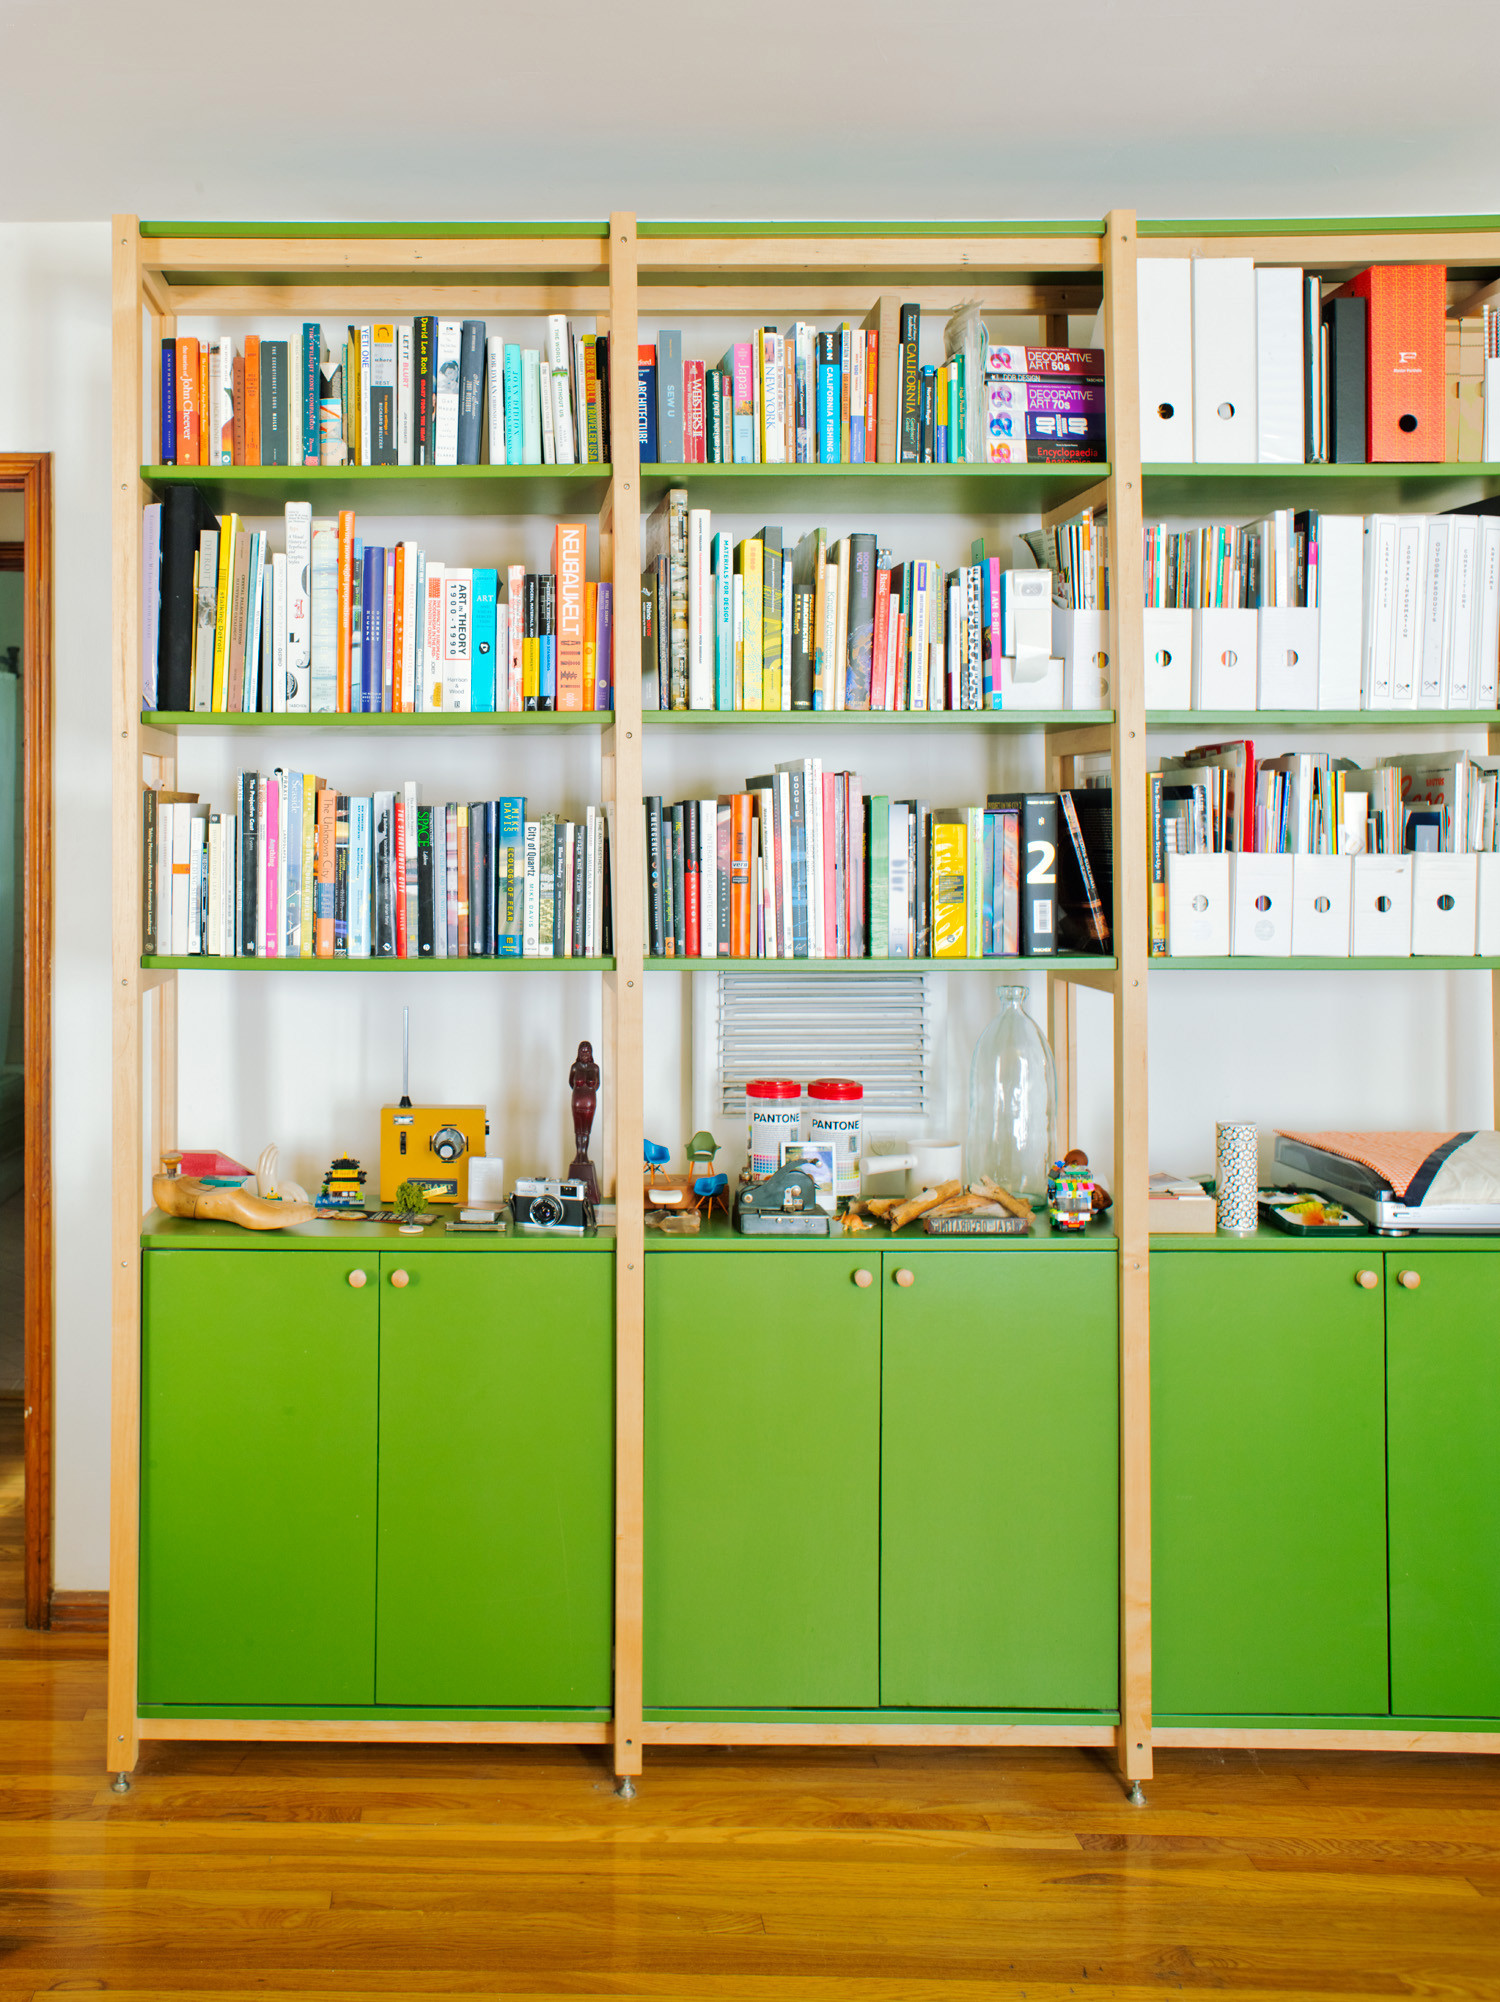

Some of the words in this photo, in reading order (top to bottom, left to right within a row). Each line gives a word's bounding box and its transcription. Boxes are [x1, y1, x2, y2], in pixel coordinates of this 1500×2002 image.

[361, 329, 369, 347] YETI
[420, 317, 428, 339] David
[361, 350, 369, 368] ONE
[402, 351, 409, 360] IT
[420, 341, 428, 355] Lee
[586, 348, 596, 370] ROCK
[826, 334, 834, 361] MOON
[868, 352, 876, 363] San
[1027, 352, 1093, 363] DECORATIVE
[420, 356, 428, 375] Roth
[1028, 361, 1050, 371] ART
[1051, 361, 1071, 371] 50s
[180, 376, 193, 399] John
[586, 381, 596, 399] ROLL
[736, 362, 750, 398] Japan
[765, 366, 776, 394] NEW
[868, 363, 876, 393] Bernardino
[906, 343, 917, 414] CALIFORNIA
[1018, 374, 1041, 382] DESIGN
[667, 384, 675, 408] SEW
[826, 366, 834, 417] CALIFORNIA
[1029, 389, 1094, 401] DECORATIVE
[559, 409, 564, 418] US
[638, 380, 648, 444] ARCHITECTURE
[667, 410, 675, 418] U
[692, 378, 703, 430] WEBSTER'S
[765, 397, 776, 430] YORK
[1029, 399, 1050, 410] ART
[1051, 399, 1071, 410] 70s
[183, 400, 193, 440] Cheever
[587, 404, 597, 443] TRAVELER
[692, 429, 703, 438] II
[826, 419, 834, 453] FISHING
[588, 444, 598, 460] USA
[1037, 447, 1098, 457] Encyclopaedia
[343, 513, 352, 544] drawing
[203, 540, 213, 580] DETROIT
[342, 563, 352, 581] eight
[862, 551, 870, 571] 1000
[458, 584, 467, 605] ART
[562, 529, 580, 636] NEUBAUWELT
[861, 572, 869, 599] LIGHTS
[879, 573, 889, 596] Basic
[217, 591, 227, 624] stalking
[342, 582, 351, 628] propositions
[825, 591, 836, 619] Kinetic
[991, 596, 1000, 610] AM
[458, 612, 467, 655] THEORY
[991, 612, 1000, 636] 8-BIT
[217, 625, 225, 653] Detroit
[825, 621, 836, 670] Architecture
[290, 779, 301, 814] Seaside
[323, 798, 334, 814] The
[397, 809, 405, 822] THE
[503, 802, 511, 832] DAVIS
[511, 808, 519, 832] MIKE
[322, 817, 333, 858] Unknown
[417, 811, 430, 847] SPACE
[527, 826, 537, 842] City
[650, 812, 658, 857] EMERGENCE
[268, 838, 277, 867] Anything
[397, 825, 405, 874] SITUATIONIST
[528, 842, 537, 850] of
[321, 859, 333, 879] City
[527, 851, 537, 877] Quartz
[1026, 840, 1056, 883] 2
[397, 876, 405, 893] CITY
[891, 860, 908, 892] blur
[507, 886, 514, 897] OF
[753, 1112, 800, 1123] PANTONE
[812, 1118, 860, 1130] PANTONE
